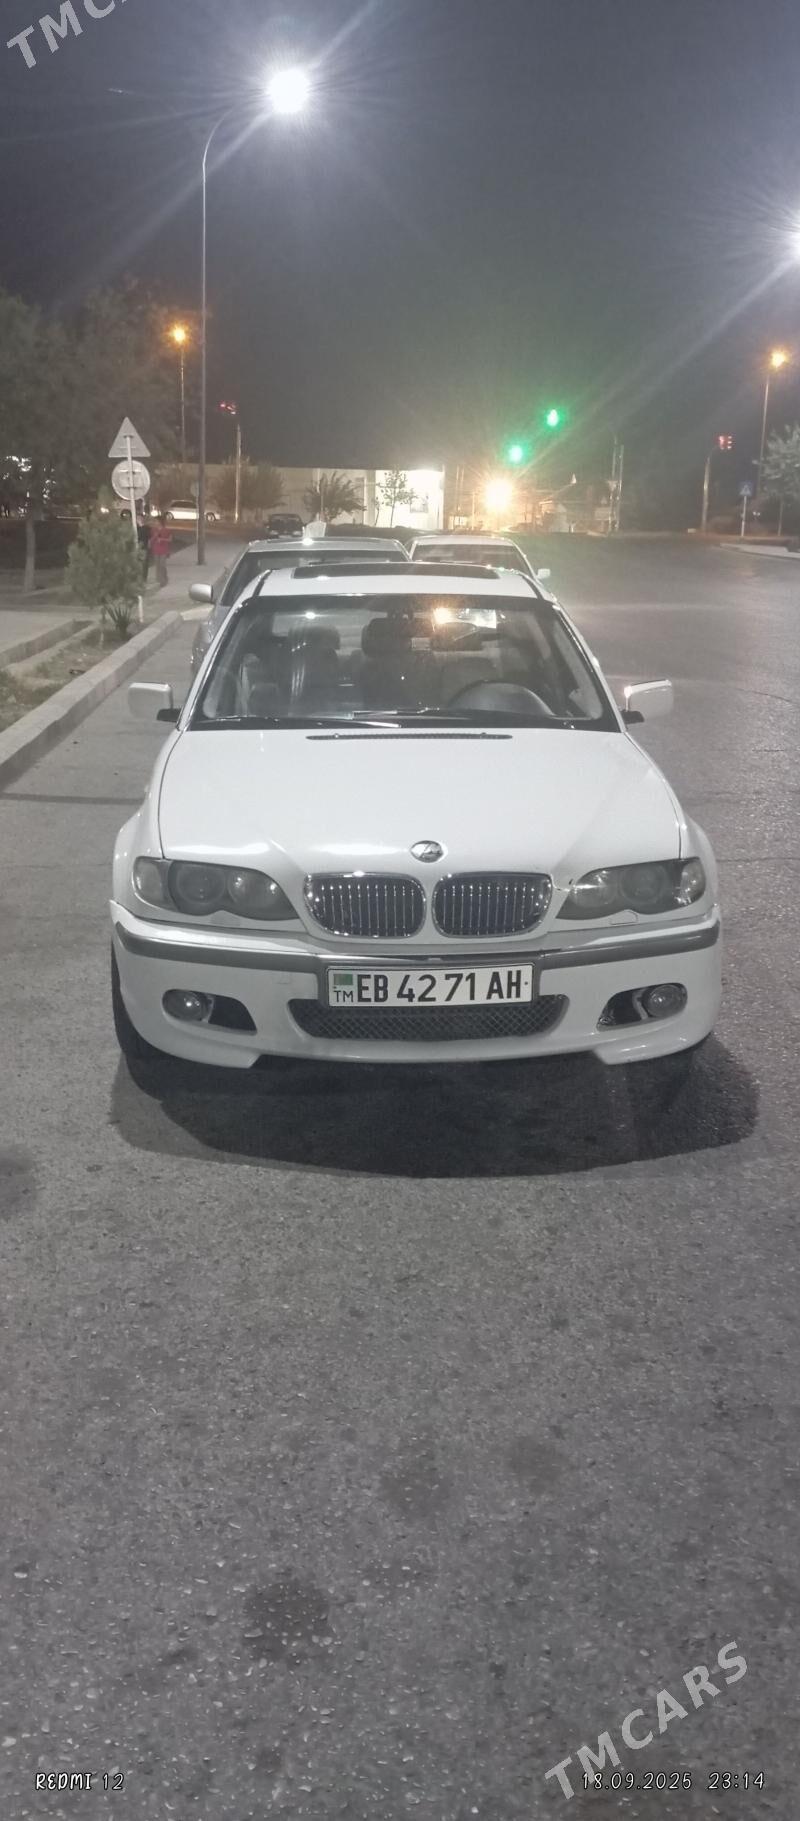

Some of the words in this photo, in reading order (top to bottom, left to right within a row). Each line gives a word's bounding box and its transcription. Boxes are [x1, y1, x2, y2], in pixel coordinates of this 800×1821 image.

[333, 990, 353, 1003] TM
[357, 974, 388, 1003] EB
[486, 970, 521, 1000] AH
